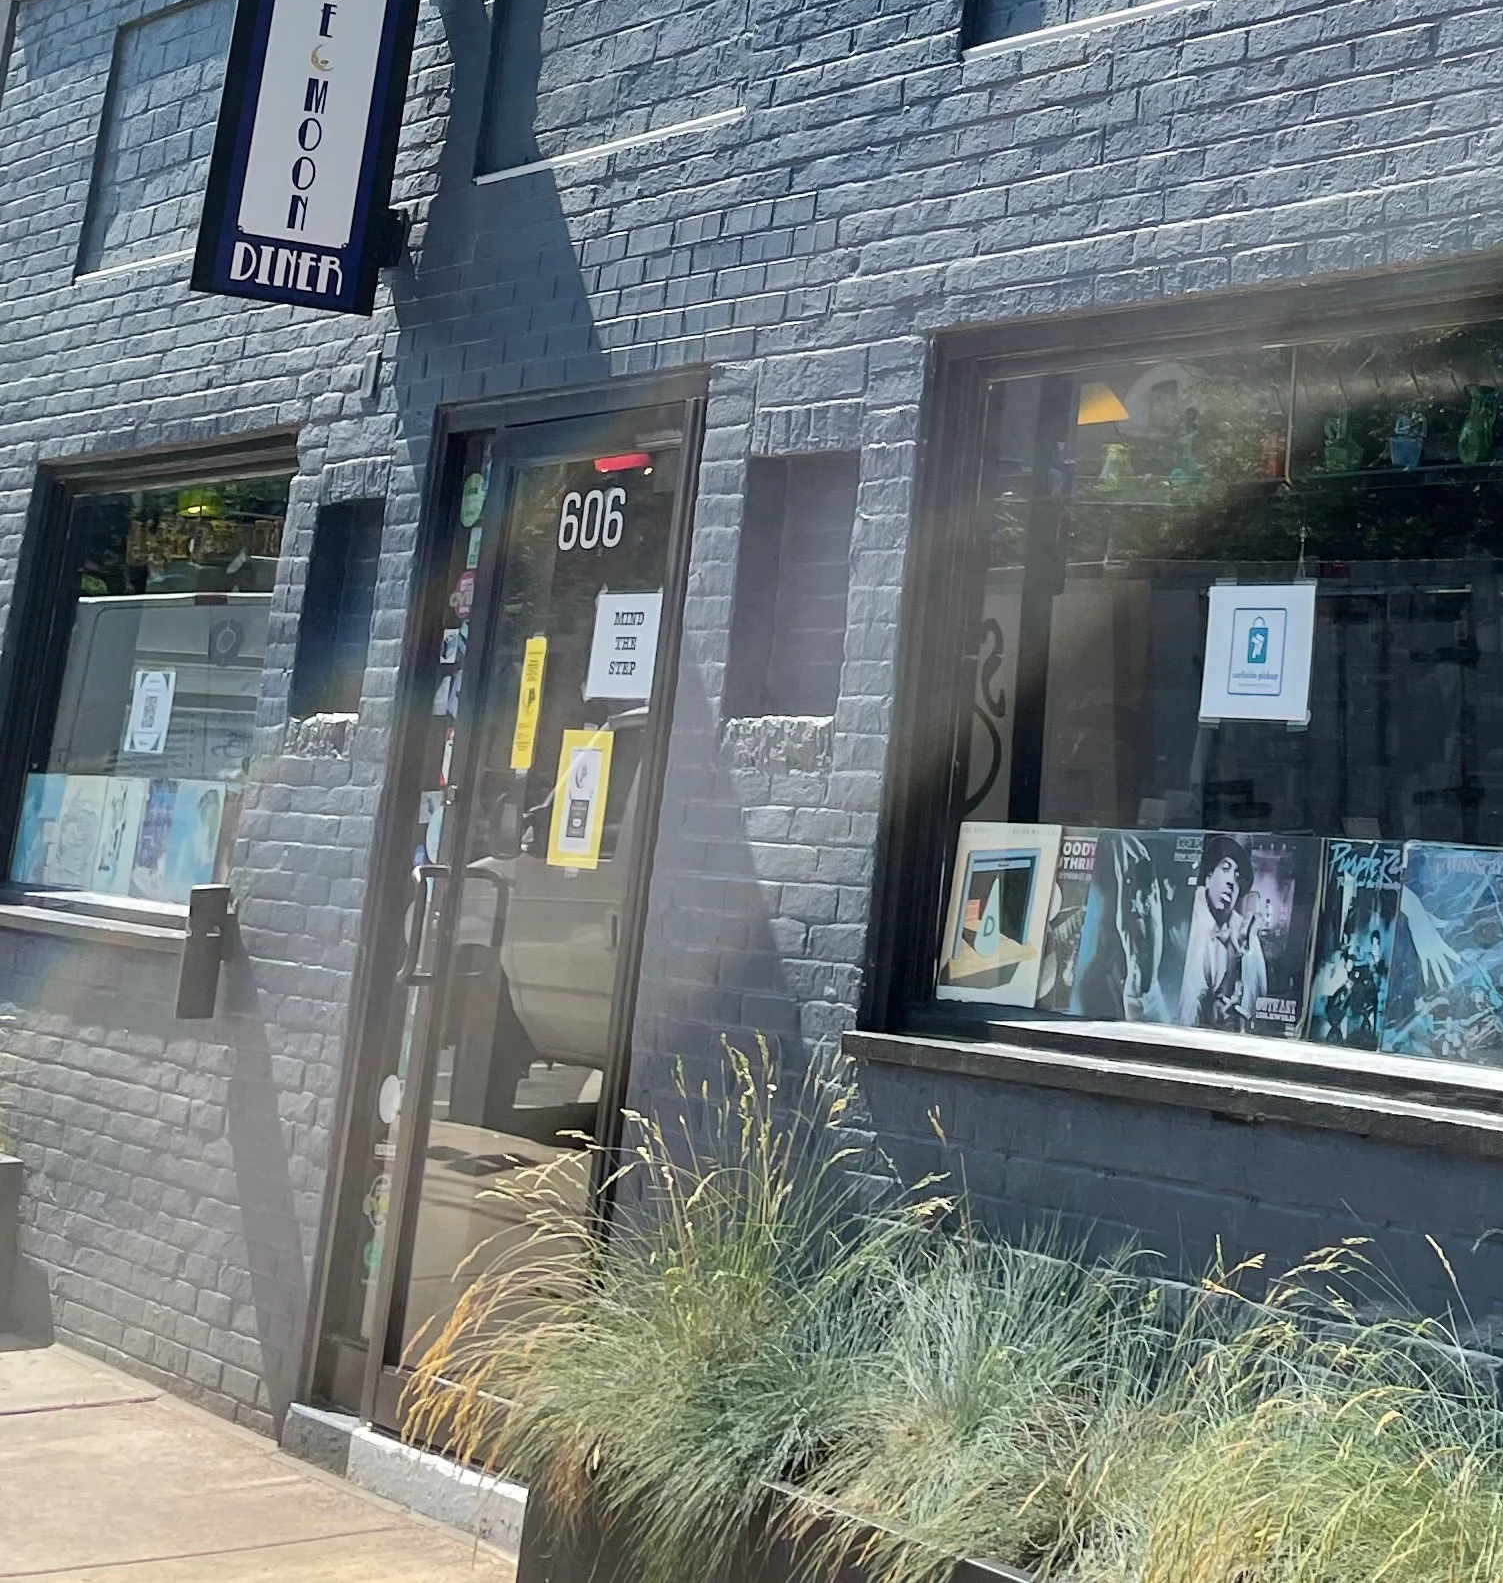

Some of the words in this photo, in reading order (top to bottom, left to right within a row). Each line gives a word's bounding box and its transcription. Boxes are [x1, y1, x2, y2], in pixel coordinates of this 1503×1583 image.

[286, 78, 328, 232] MOON
[229, 241, 343, 296] DINER
[558, 487, 626, 551] 606
[614, 612, 645, 626] MIND
[615, 636, 638, 650] THE
[608, 661, 636, 675] STEP
